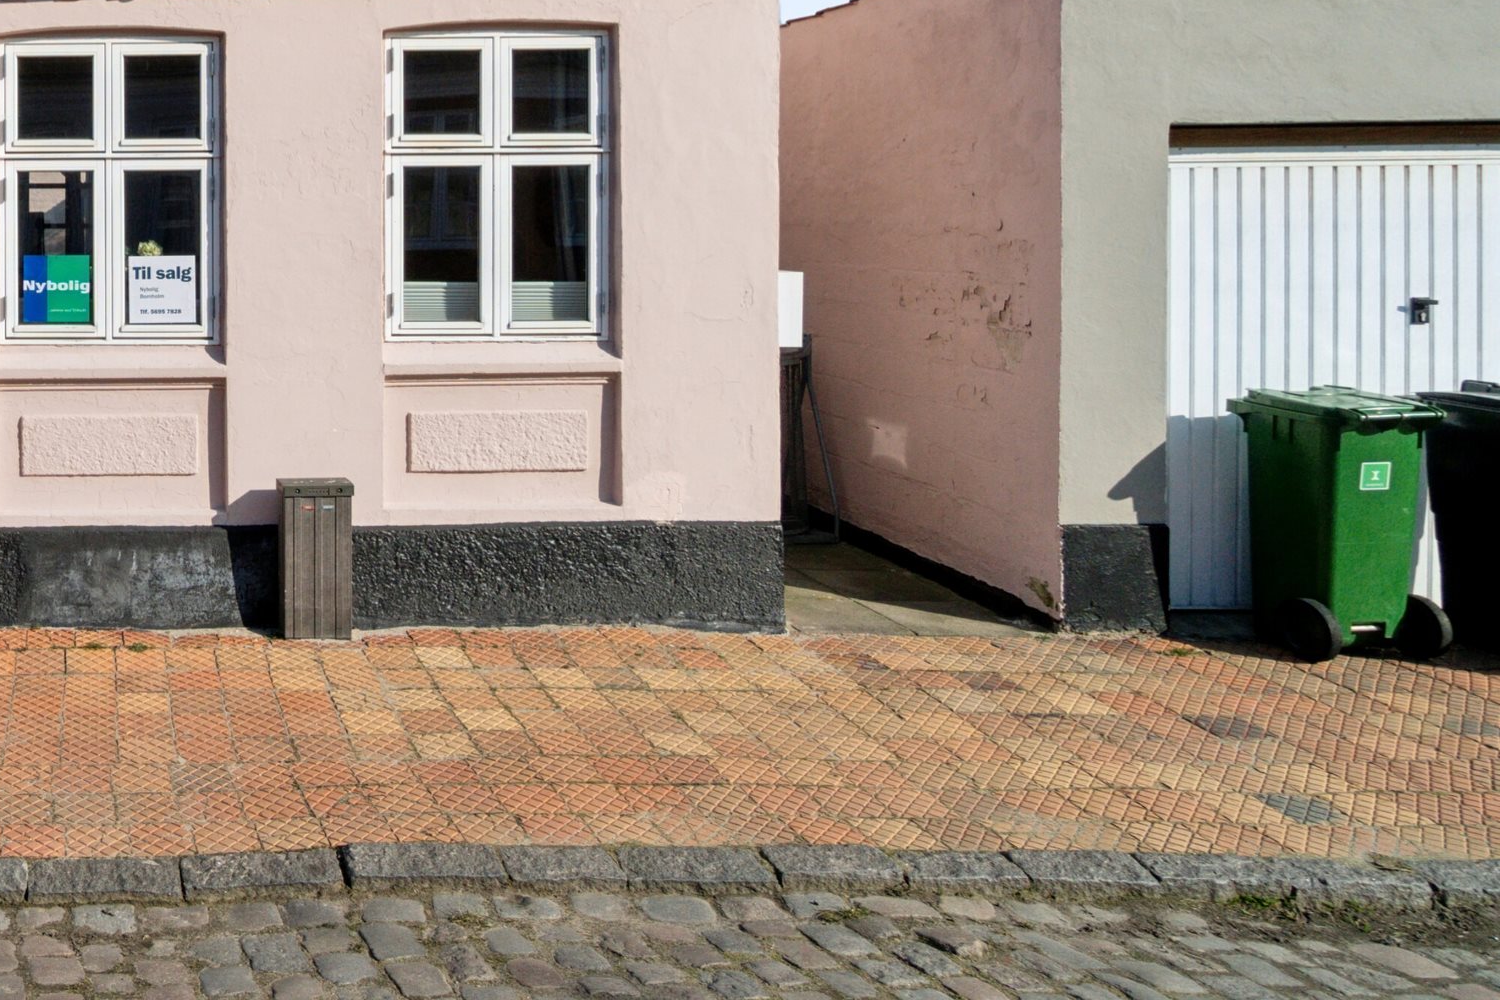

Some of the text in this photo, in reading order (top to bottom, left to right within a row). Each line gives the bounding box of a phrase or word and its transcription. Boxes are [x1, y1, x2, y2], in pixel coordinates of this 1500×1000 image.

[132, 266, 192, 282] Til salg
[23, 279, 90, 294] Nybolig
